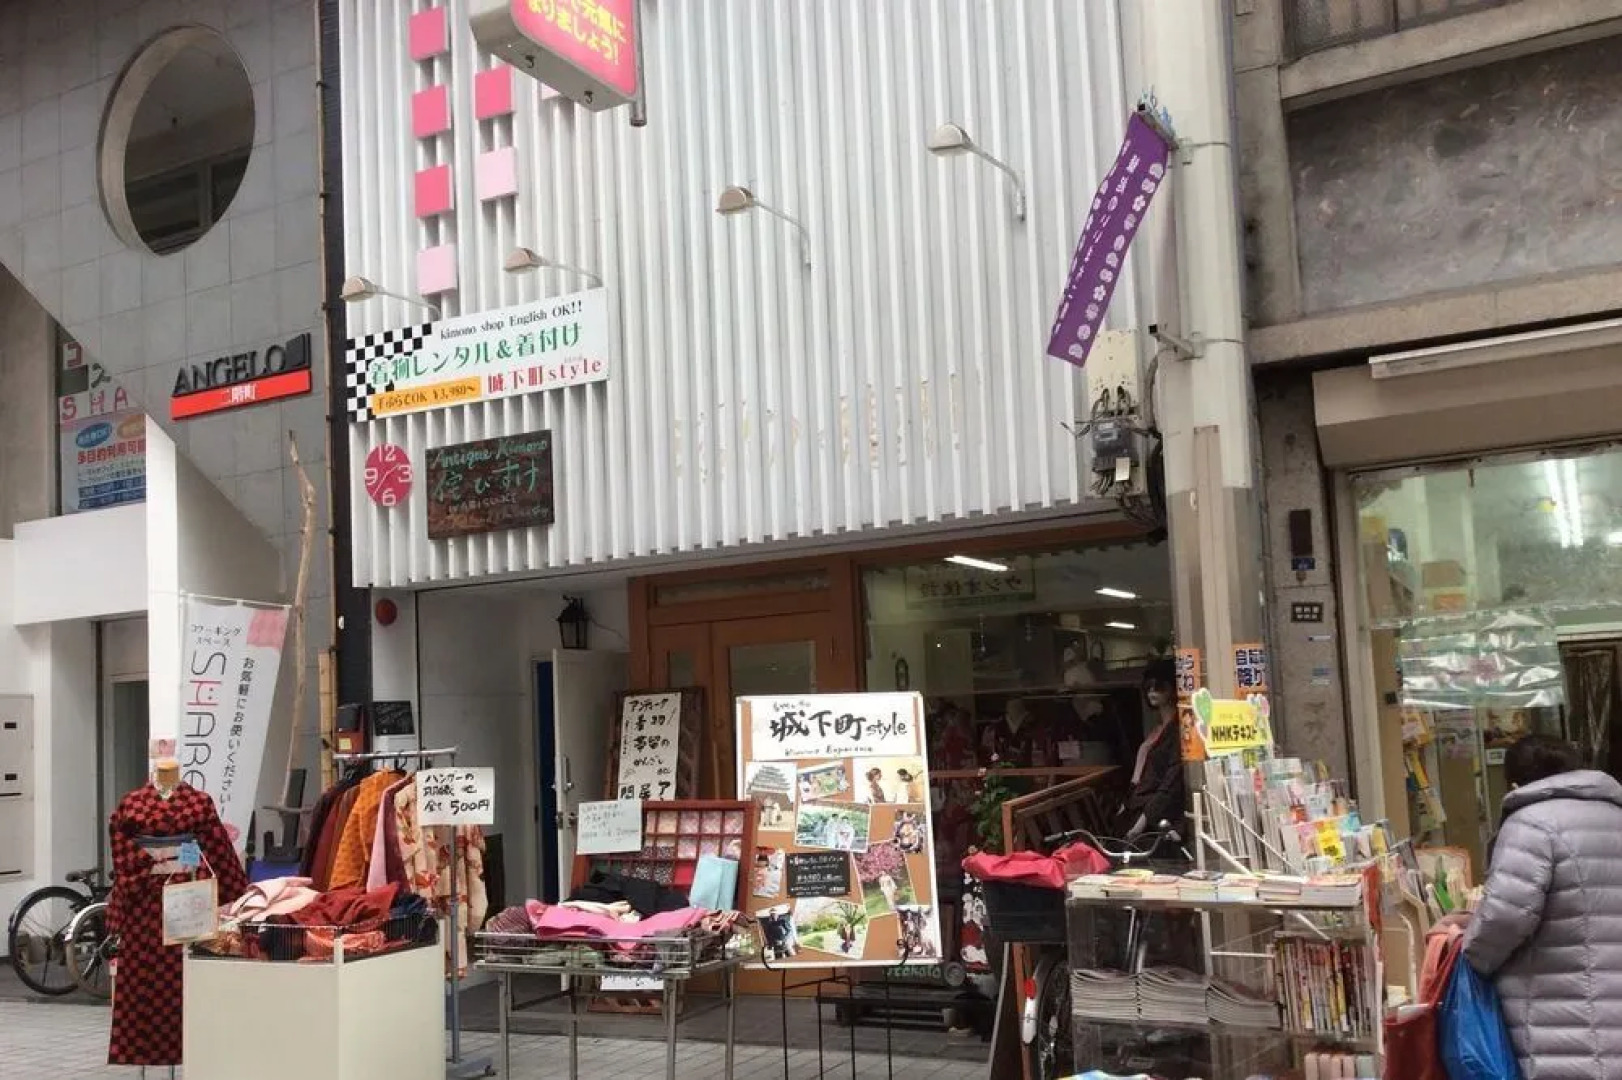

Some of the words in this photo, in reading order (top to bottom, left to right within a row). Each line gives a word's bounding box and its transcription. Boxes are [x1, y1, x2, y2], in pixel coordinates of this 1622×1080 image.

[440, 324, 477, 340] kimono
[480, 318, 504, 334] shop
[509, 309, 547, 326] English
[552, 299, 582, 317] OK!!
[172, 344, 287, 398] ANGELO
[379, 443, 396, 462] 12
[364, 468, 378, 486] 9
[398, 464, 412, 483] 3
[382, 487, 396, 506] 6
[449, 798, 491, 816] 500円
